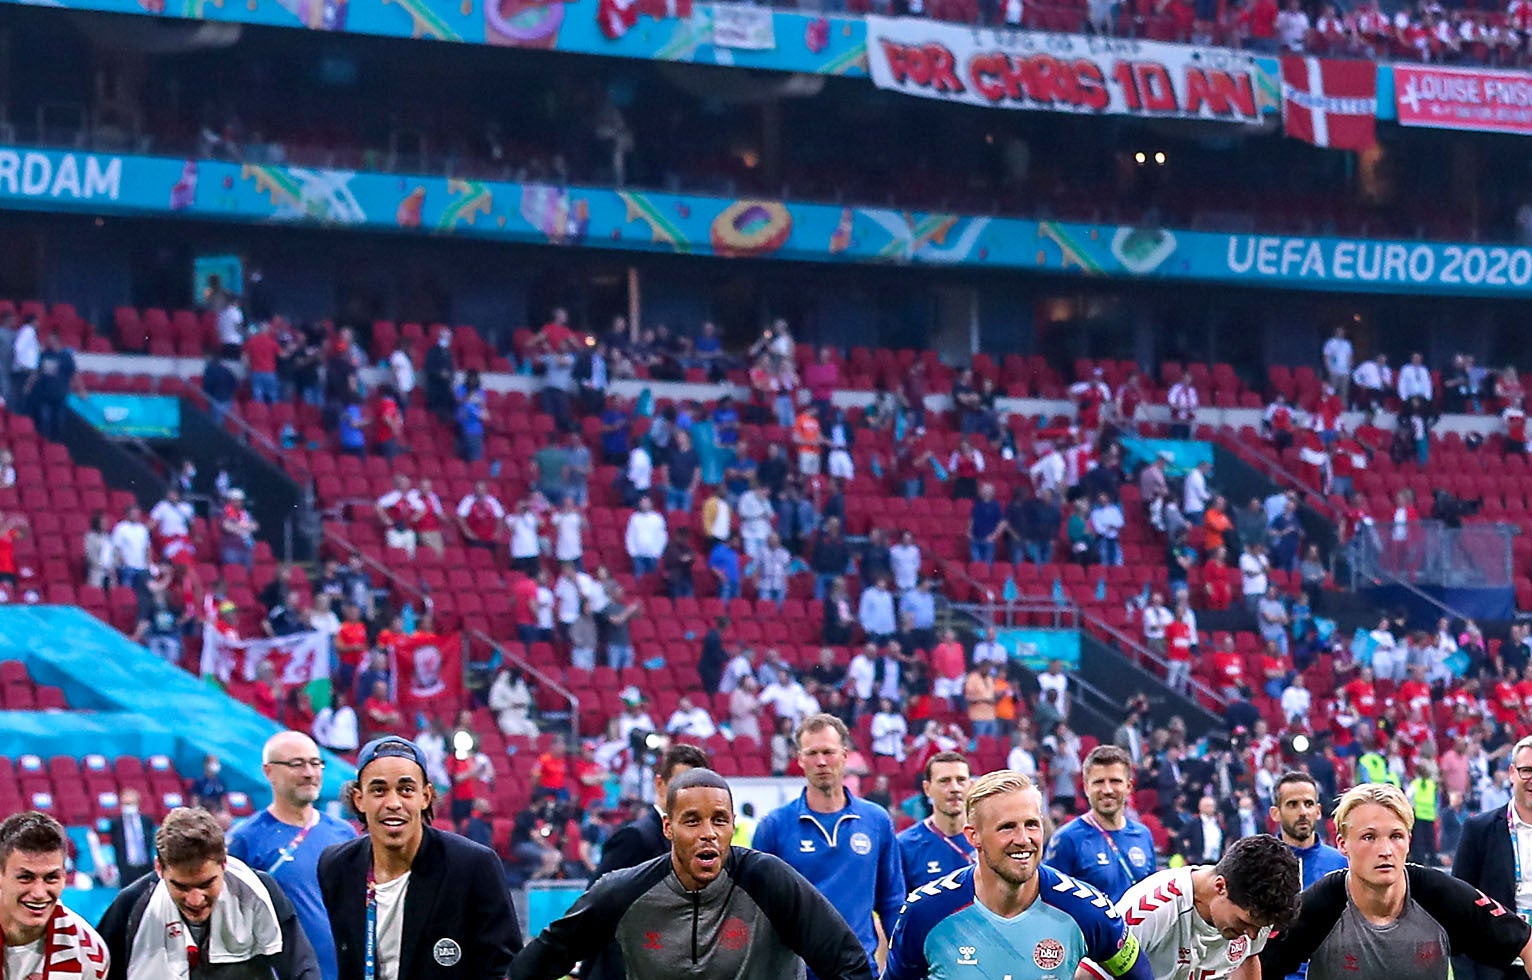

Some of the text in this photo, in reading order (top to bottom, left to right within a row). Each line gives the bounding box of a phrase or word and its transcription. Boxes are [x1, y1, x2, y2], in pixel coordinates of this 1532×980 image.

[879, 38, 968, 93] FOR
[967, 53, 1109, 112] CHRIS
[1400, 74, 1482, 114] LOUISE
[1227, 235, 1326, 278] UEFA
[1332, 242, 1436, 282] EURO
